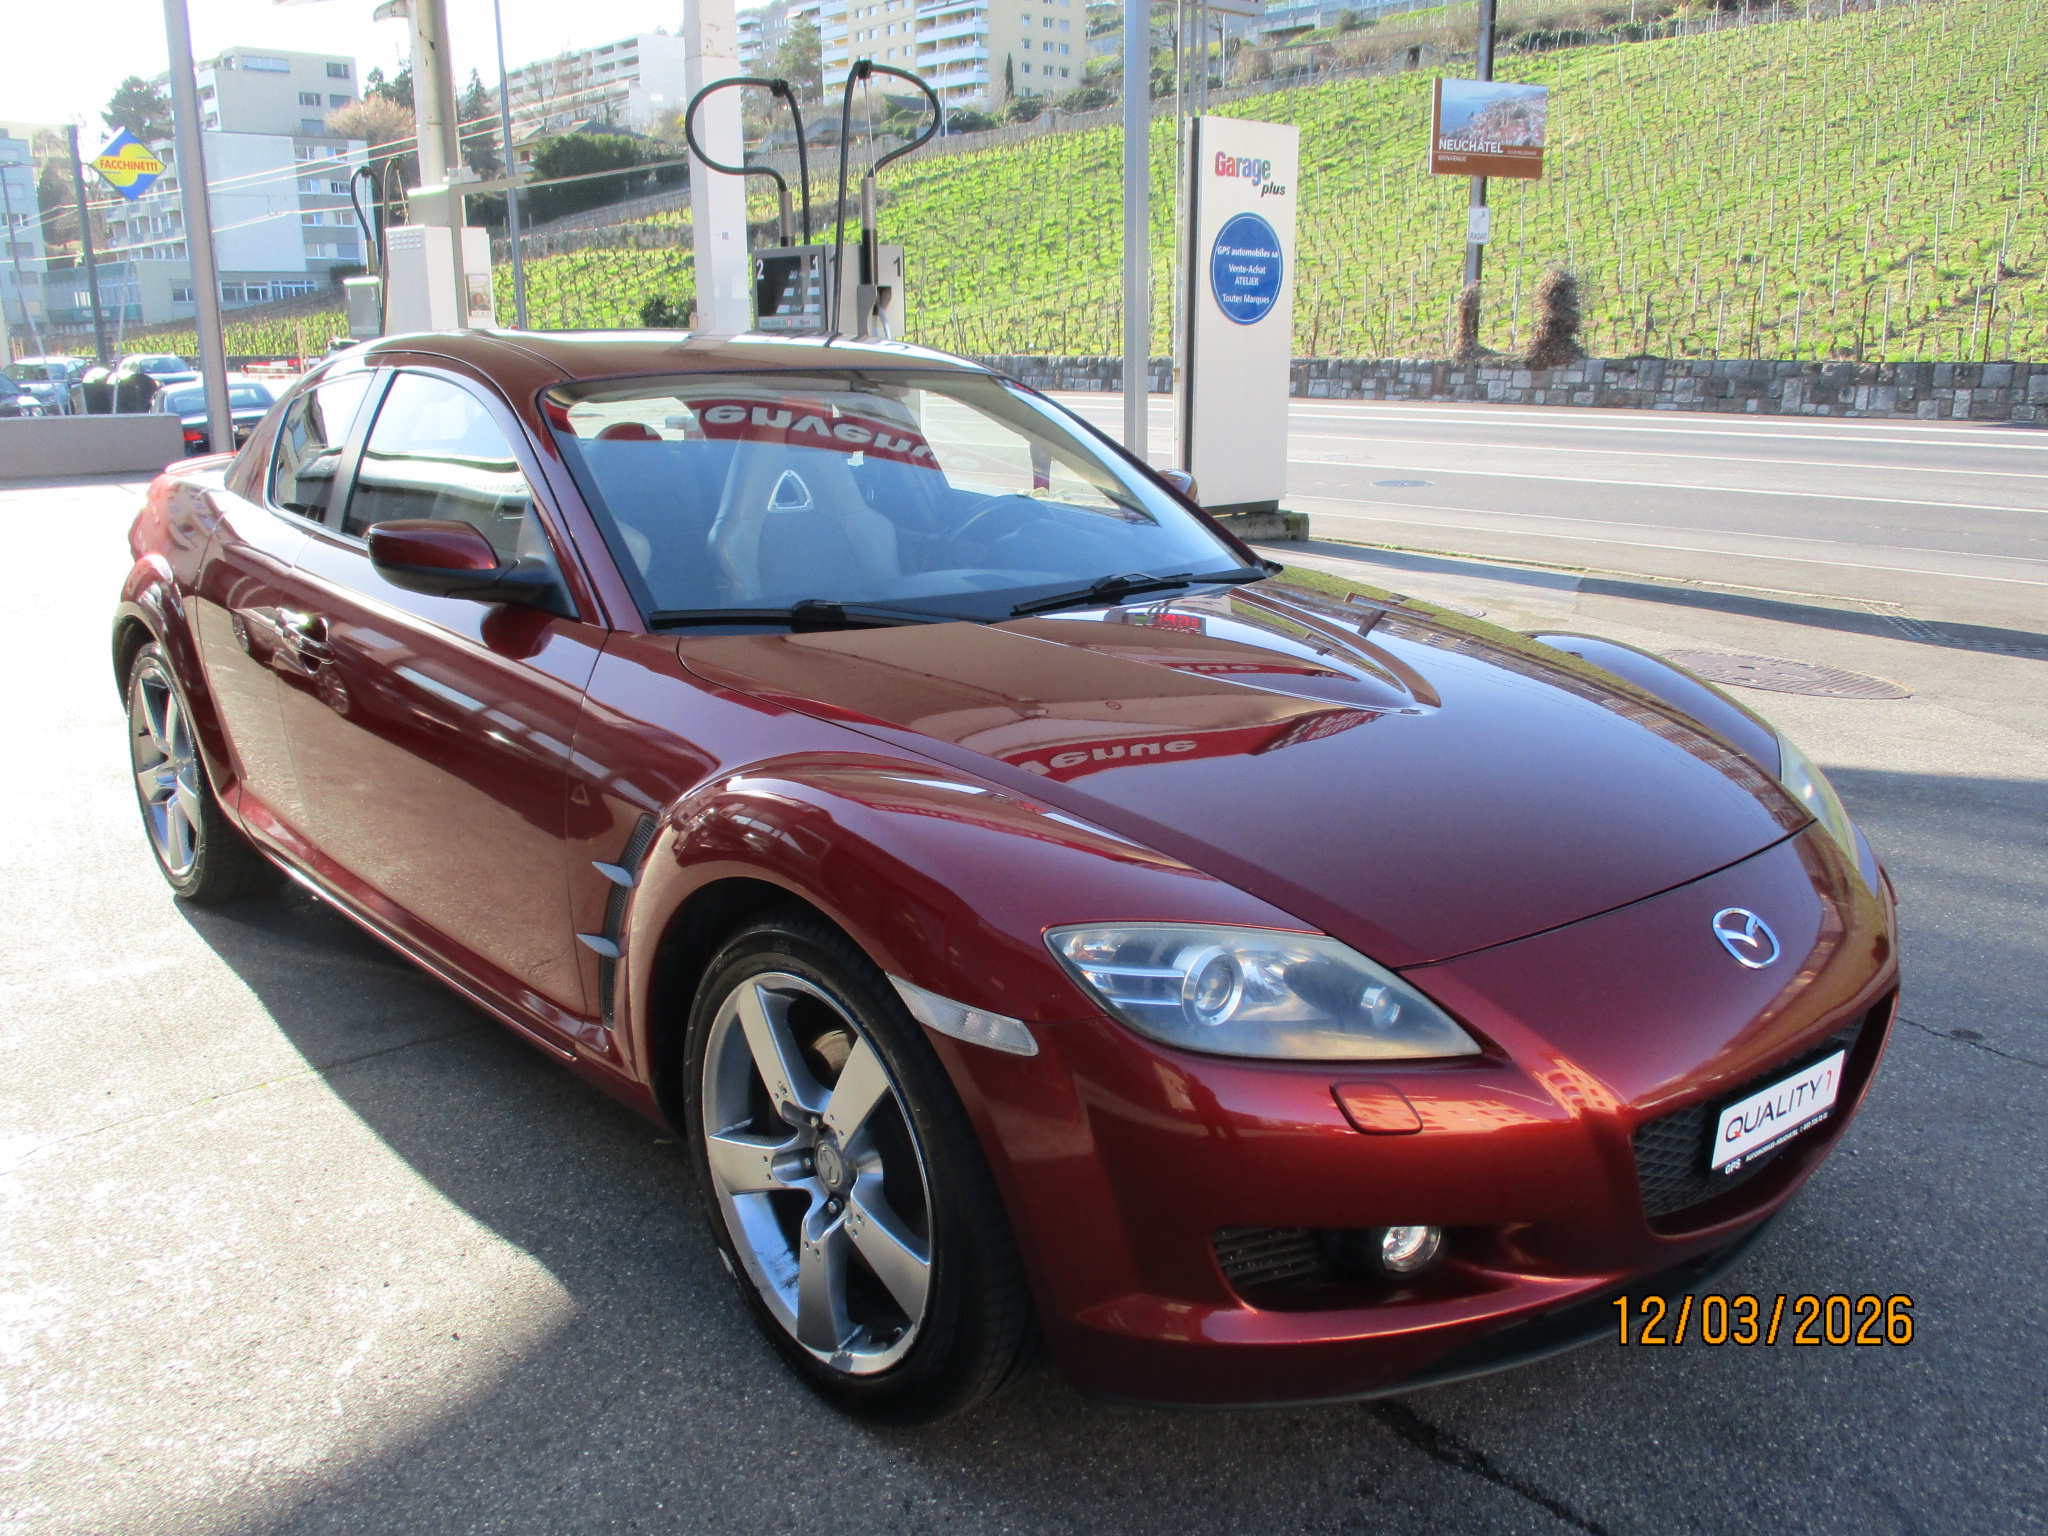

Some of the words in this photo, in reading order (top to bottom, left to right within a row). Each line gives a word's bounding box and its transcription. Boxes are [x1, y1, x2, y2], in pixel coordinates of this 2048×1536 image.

[1438, 138, 1503, 154] NEUCHÂTEL
[100, 159, 158, 172] FACCHINETTI
[1214, 151, 1271, 186] Garage
[1261, 181, 1286, 198] plus
[1217, 245, 1230, 255] GPS
[1231, 247, 1270, 258] automobiles
[756, 259, 765, 280] 2
[893, 257, 901, 277] 1
[1228, 264, 1266, 275] Vente-Achat
[1234, 276, 1259, 286] ATELIER
[1222, 293, 1243, 303] Toutes
[1243, 295, 1270, 305] Marques
[1724, 1159, 1741, 1175] GPS
